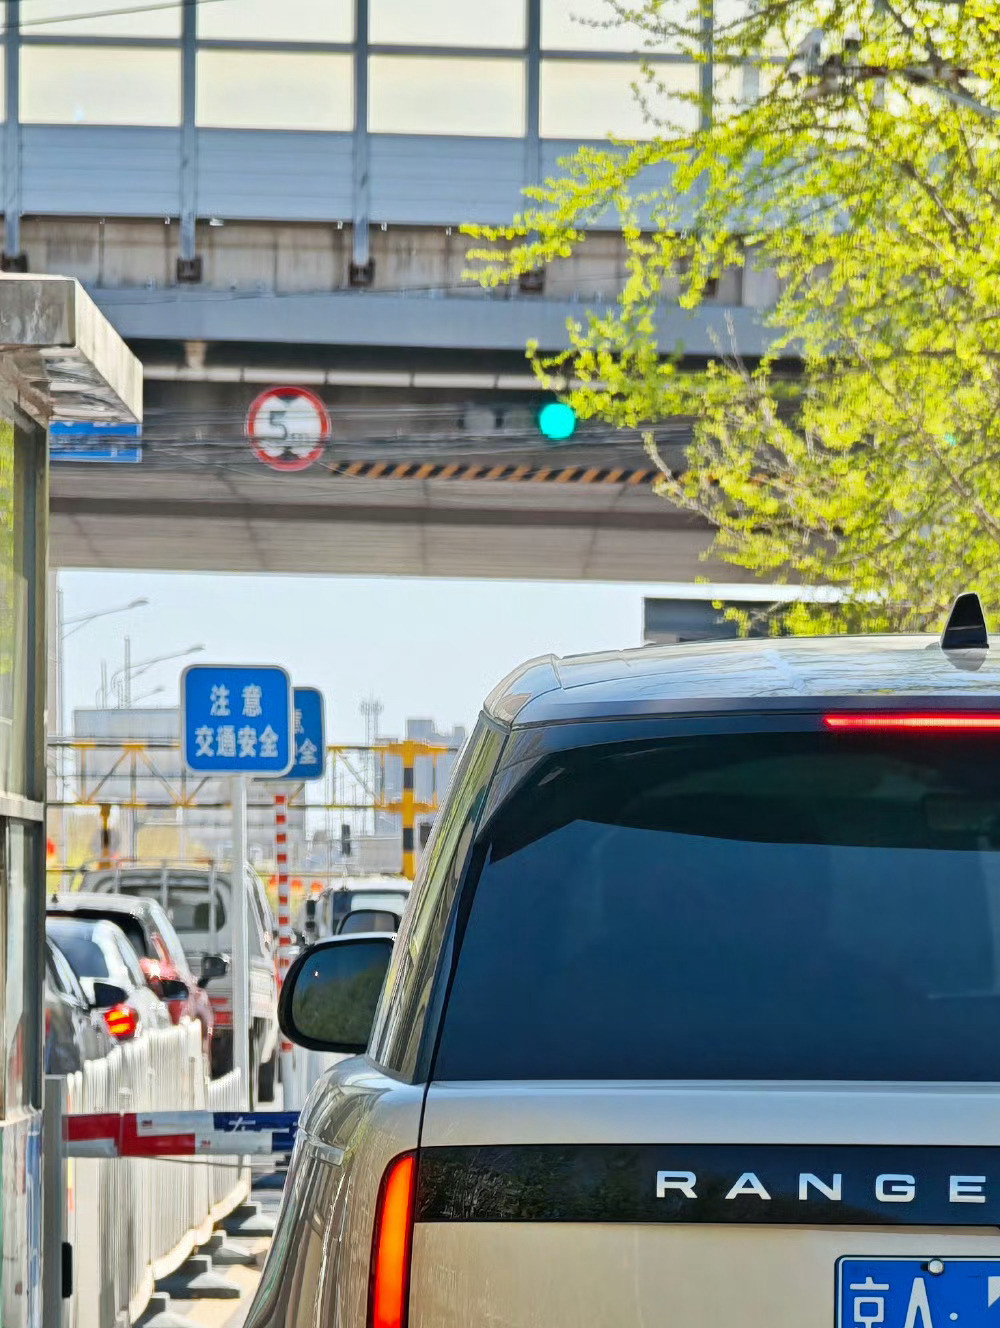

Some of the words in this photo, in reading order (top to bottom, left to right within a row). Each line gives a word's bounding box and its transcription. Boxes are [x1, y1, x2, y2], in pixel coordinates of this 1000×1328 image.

[210, 683, 262, 717] 注意
[195, 724, 279, 757] 交通安全
[656, 1170, 988, 1204] RANGE
